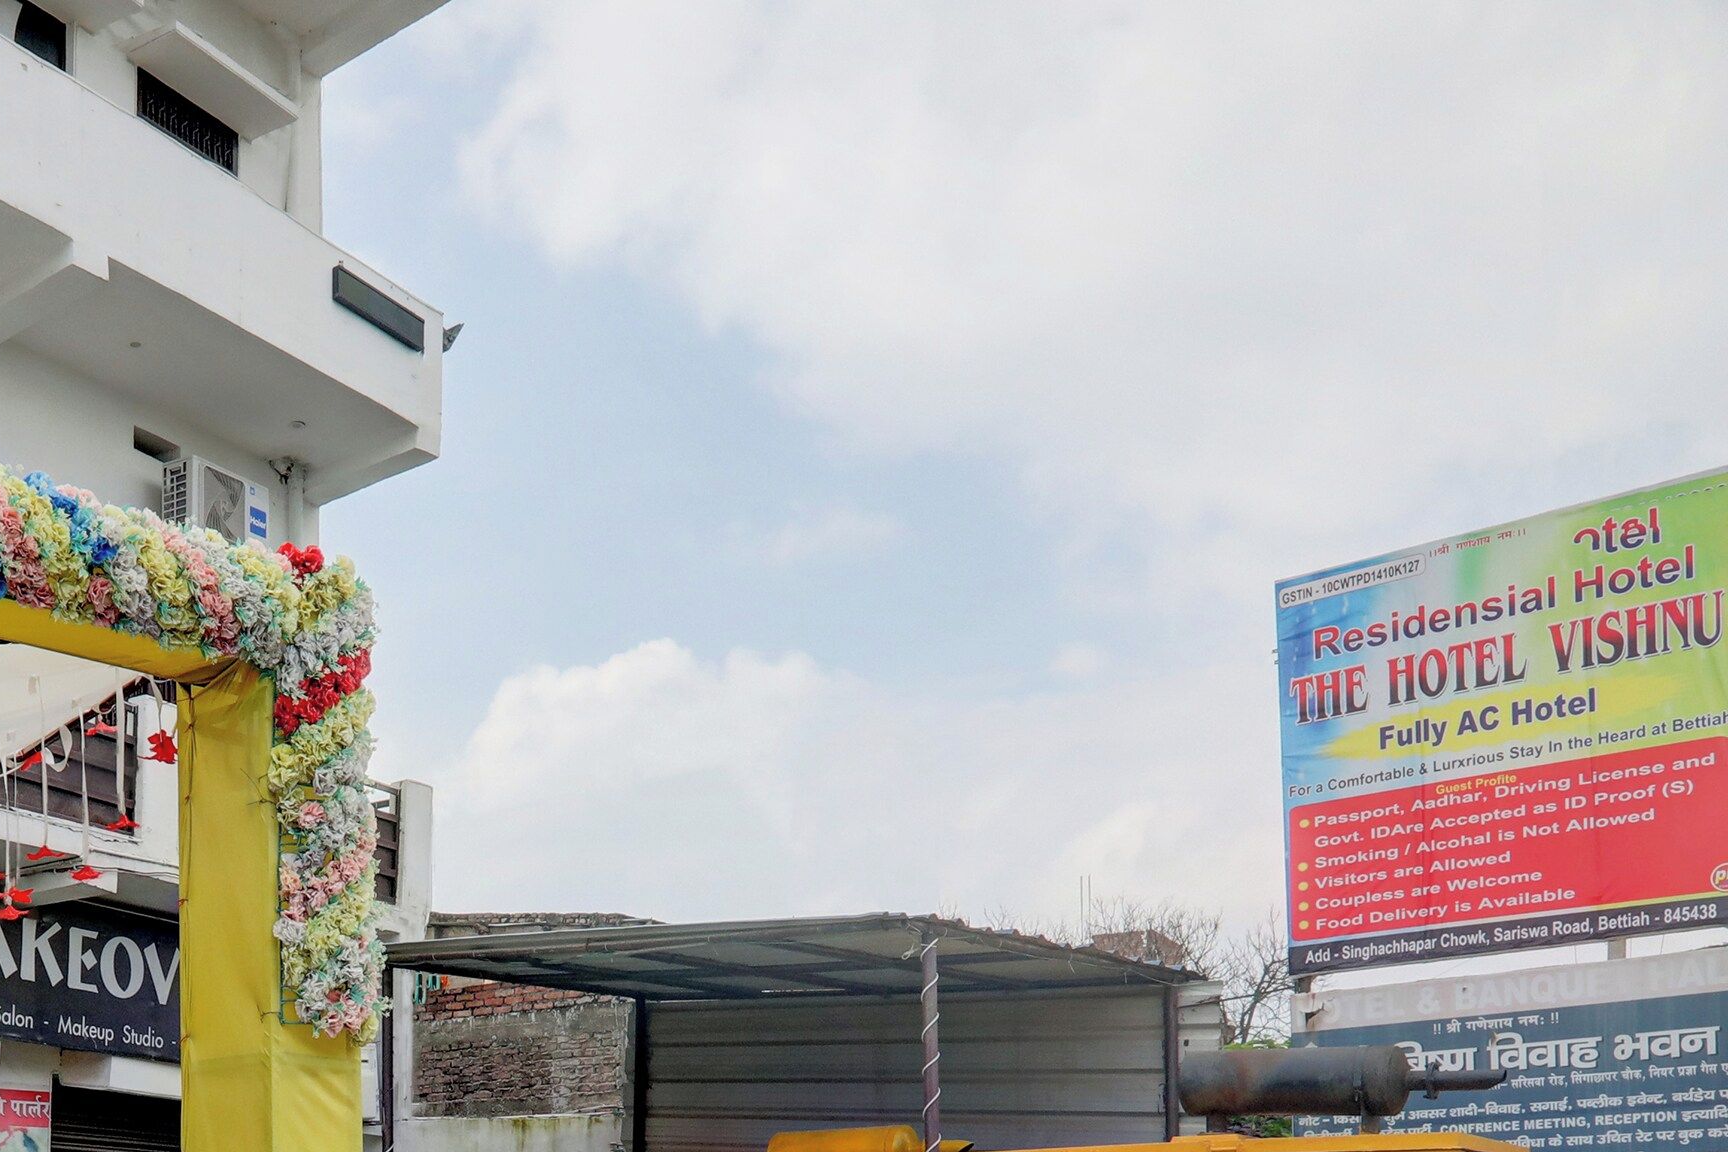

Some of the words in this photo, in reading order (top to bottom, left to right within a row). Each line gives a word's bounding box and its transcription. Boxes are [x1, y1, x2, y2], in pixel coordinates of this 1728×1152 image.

[1282, 588, 1313, 605] GSTIN
[1313, 575, 1556, 660] Residensial
[1574, 544, 1695, 604] Hotel
[1290, 664, 1369, 725] THE
[1386, 632, 1528, 706] HOTEL
[1547, 589, 1725, 674] VISHNU
[1379, 718, 1448, 750] Fully
[1457, 705, 1500, 736] AC
[1511, 687, 1596, 726] Hotel
[1289, 784, 1313, 798] For
[1327, 765, 1414, 791] Comfortable
[1419, 762, 1428, 775] &
[1433, 749, 1505, 773] Lurxrious
[1509, 743, 1543, 760] Stay
[1548, 740, 1563, 754] In
[1568, 735, 1593, 750] the
[1598, 725, 1646, 745] Heard
[1651, 722, 1667, 736] at
[1314, 804, 1405, 828] Passport,
[1411, 792, 1488, 812] Aadhar,
[1495, 777, 1571, 798] Driving
[1578, 762, 1665, 786] License
[1672, 752, 1716, 770] and
[1435, 779, 1473, 795] Guest
[1314, 832, 1364, 848] Govt.
[1430, 804, 1526, 830] Accepted
[1533, 801, 1557, 814] as
[1565, 796, 1587, 810] ID
[1594, 785, 1655, 806] Proof
[1662, 779, 1694, 798] (S)
[1315, 848, 1399, 869] Smoking
[1416, 832, 1491, 854] Alcohal
[1498, 829, 1515, 841] is
[1523, 822, 1560, 838] Not
[1565, 808, 1655, 833] Allowed
[1314, 867, 1387, 890] Visitors
[1394, 864, 1423, 877] are
[1429, 851, 1511, 873] Allowed
[1315, 889, 1405, 910] Coupless
[1411, 884, 1441, 897] are
[1446, 870, 1543, 892] Welcome
[1315, 913, 1363, 931] Food
[1369, 903, 1448, 923] Delivery
[1454, 901, 1471, 913] is
[1478, 888, 1576, 911] Available
[1305, 948, 1331, 965] Add
[1342, 936, 1437, 962] Singhachhapar
[1440, 928, 1490, 951] Chowk,
[1494, 924, 1548, 942] Sariswa
[1552, 917, 1593, 937] Road,
[1598, 908, 1650, 930] Bettiah
[1663, 903, 1717, 924] 845438
[58, 1016, 114, 1046] Makeup
[122, 1025, 164, 1049] Studio
[1446, 1019, 1461, 1034] श्री
[1466, 1017, 1513, 1031] गणेशाय
[1487, 1032, 1603, 1070] विवाह
[1614, 1025, 1721, 1062] भवन
[1408, 1108, 1446, 1120] अवसर
[1524, 1117, 1590, 1131] MEETING,
[1595, 1111, 1677, 1125] RECEPTION
[1566, 1135, 1593, 1146] साथ
[1656, 1129, 1675, 1141] पर
[1678, 1128, 1704, 1145] बुक
